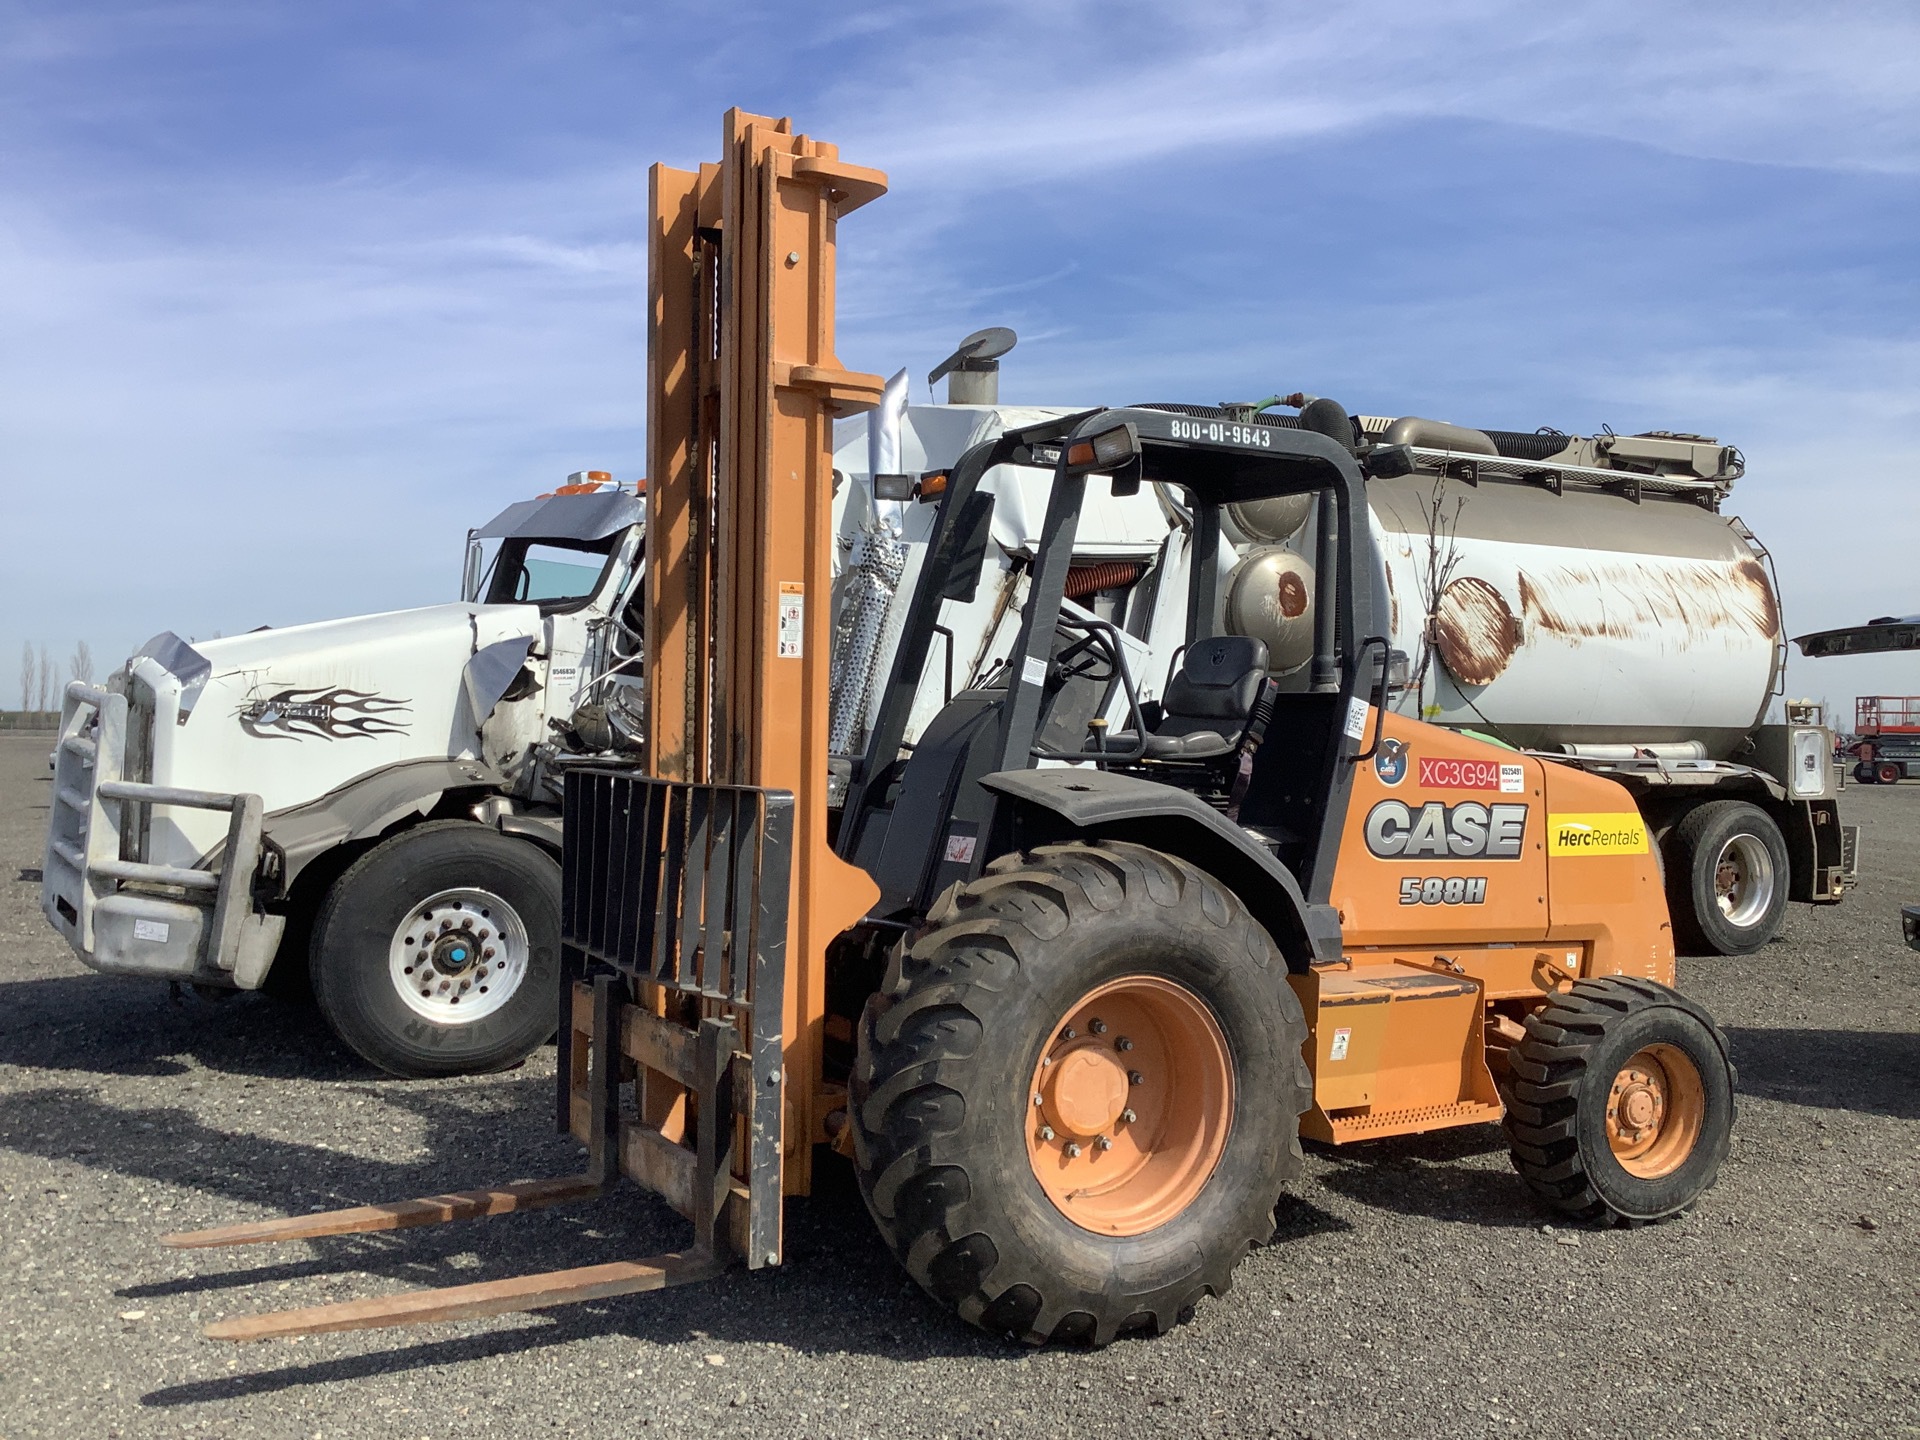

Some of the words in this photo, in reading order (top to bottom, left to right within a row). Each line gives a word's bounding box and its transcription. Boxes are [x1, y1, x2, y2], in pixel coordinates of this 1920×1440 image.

[1171, 420, 1271, 448] 800-01-9643
[1420, 760, 1498, 787] XC3G94
[1365, 801, 1528, 858] CASE
[1558, 828, 1640, 847] HercRentals
[1399, 877, 1488, 906] 588H
